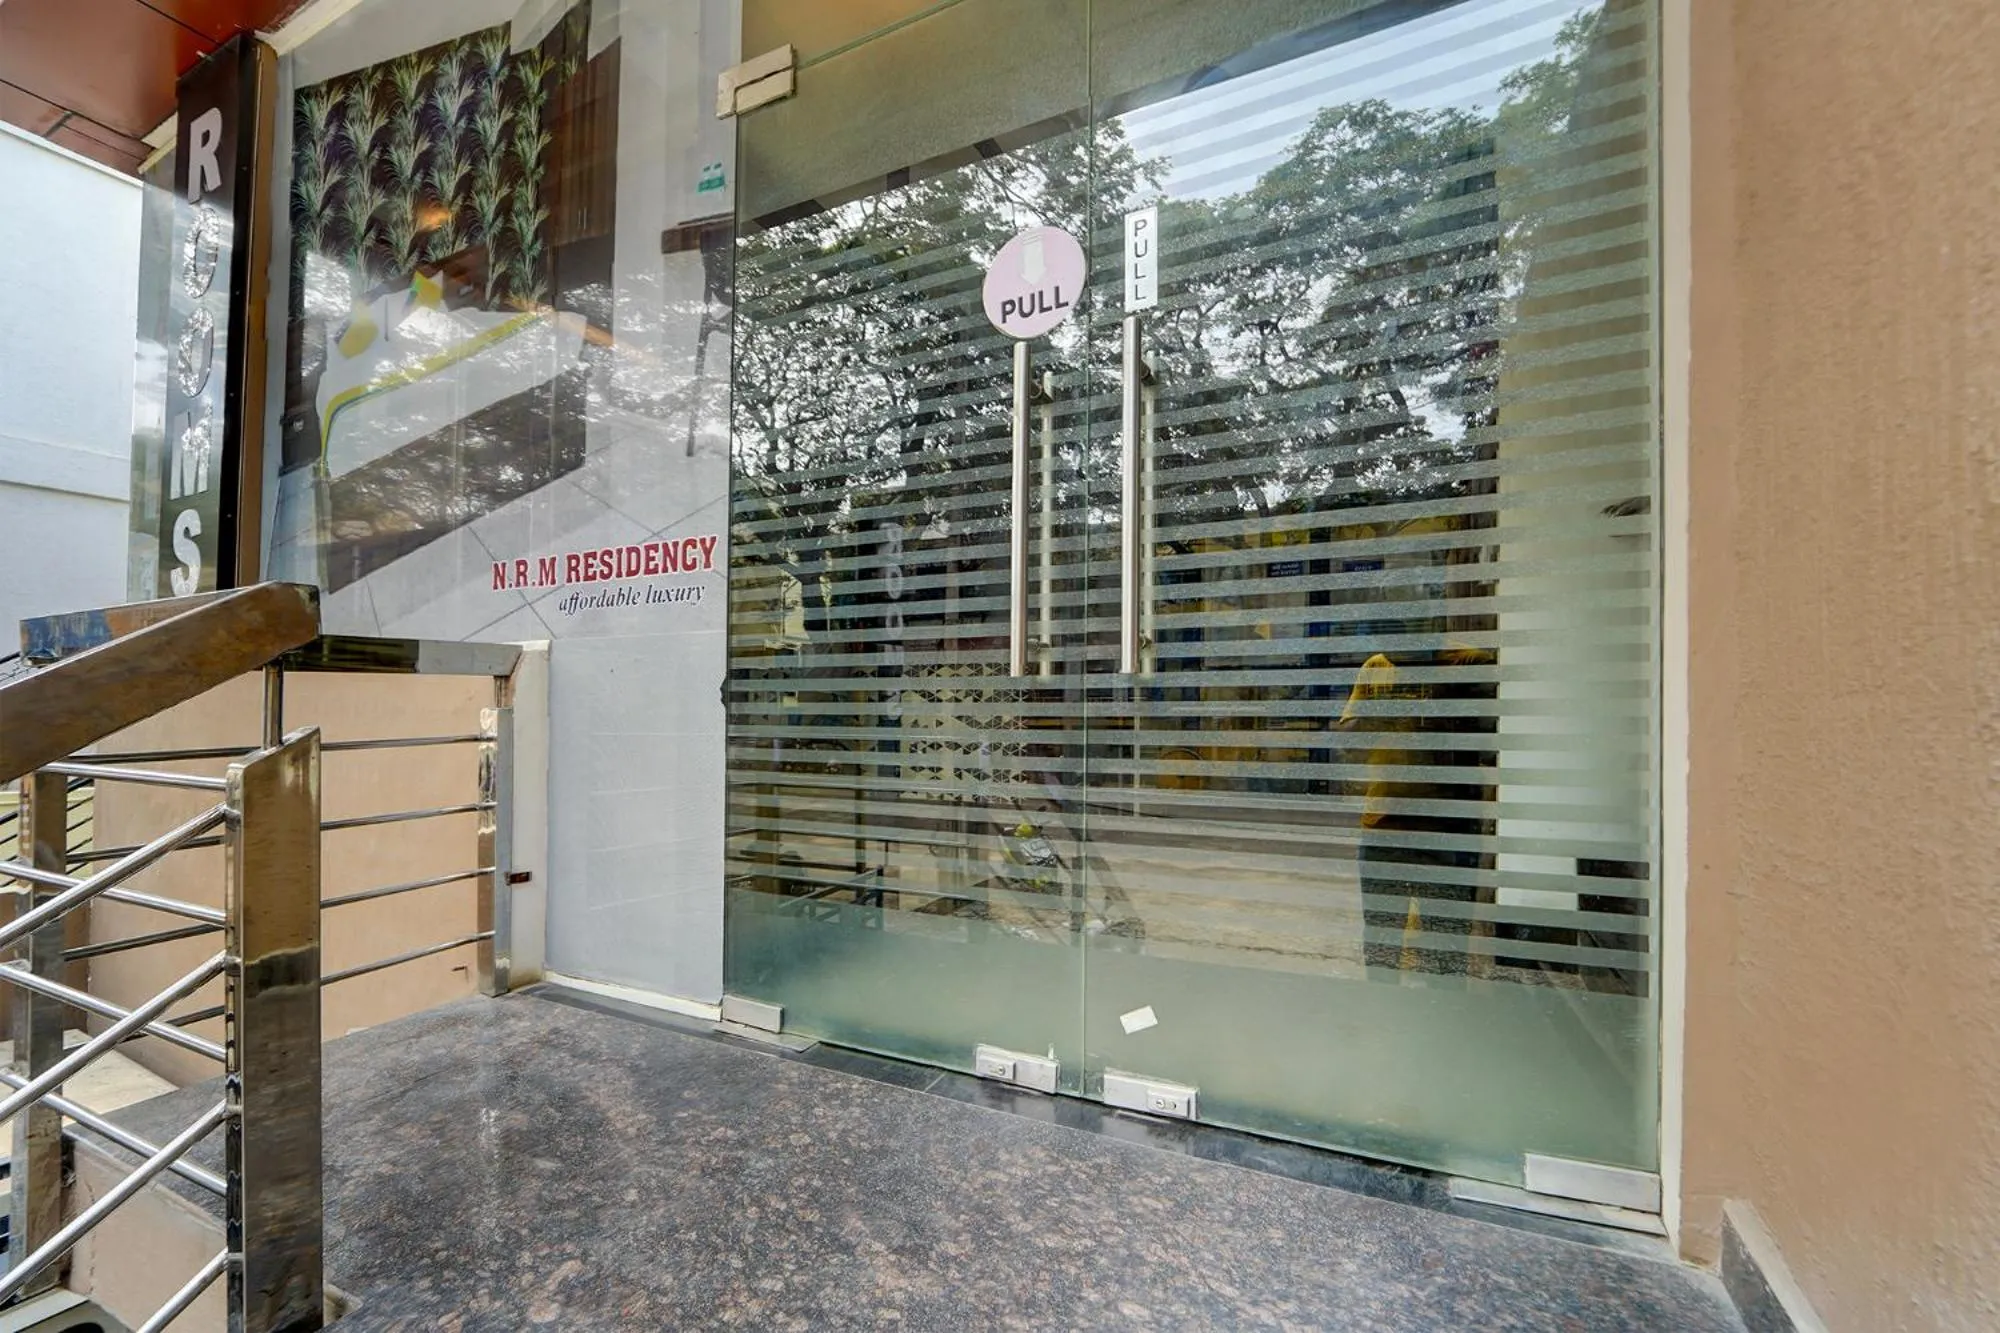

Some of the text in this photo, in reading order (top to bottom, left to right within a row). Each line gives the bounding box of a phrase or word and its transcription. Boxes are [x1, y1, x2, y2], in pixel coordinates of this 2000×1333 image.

[1134, 218, 1148, 301] PULL
[1001, 286, 1069, 324] PULL
[170, 107, 223, 597] ROOMS
[492, 536, 717, 590] N.R.M RESIDENCY
[558, 584, 705, 616] affordable luxury
